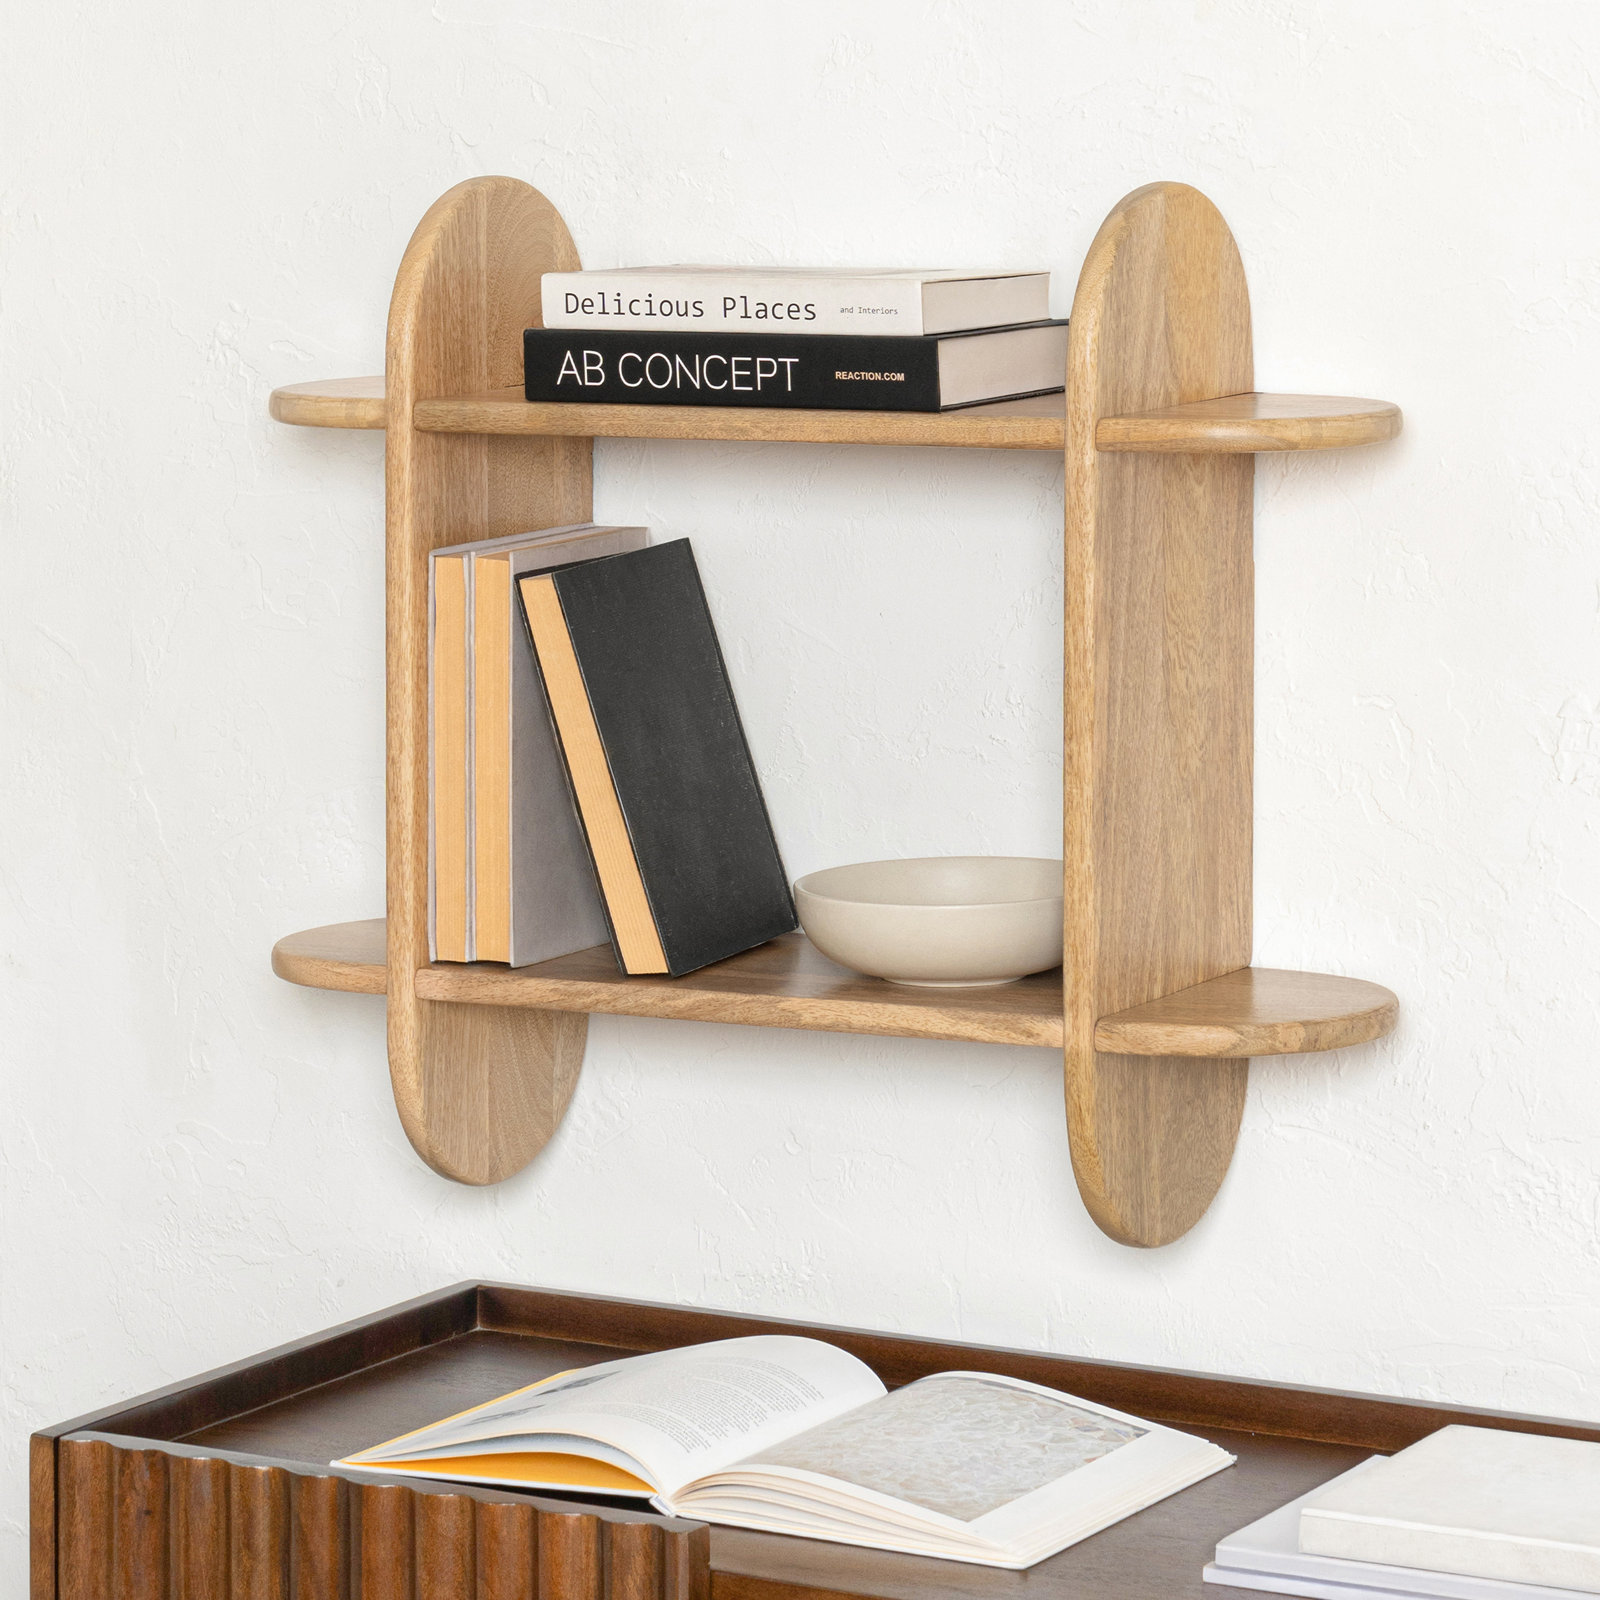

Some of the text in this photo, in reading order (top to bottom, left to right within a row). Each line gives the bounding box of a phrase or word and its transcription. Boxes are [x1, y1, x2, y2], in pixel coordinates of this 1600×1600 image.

[564, 291, 899, 321] Delicious Places and Interiors
[556, 349, 800, 392] AB CONCEPT
[834, 370, 905, 382] REACTION.COM
